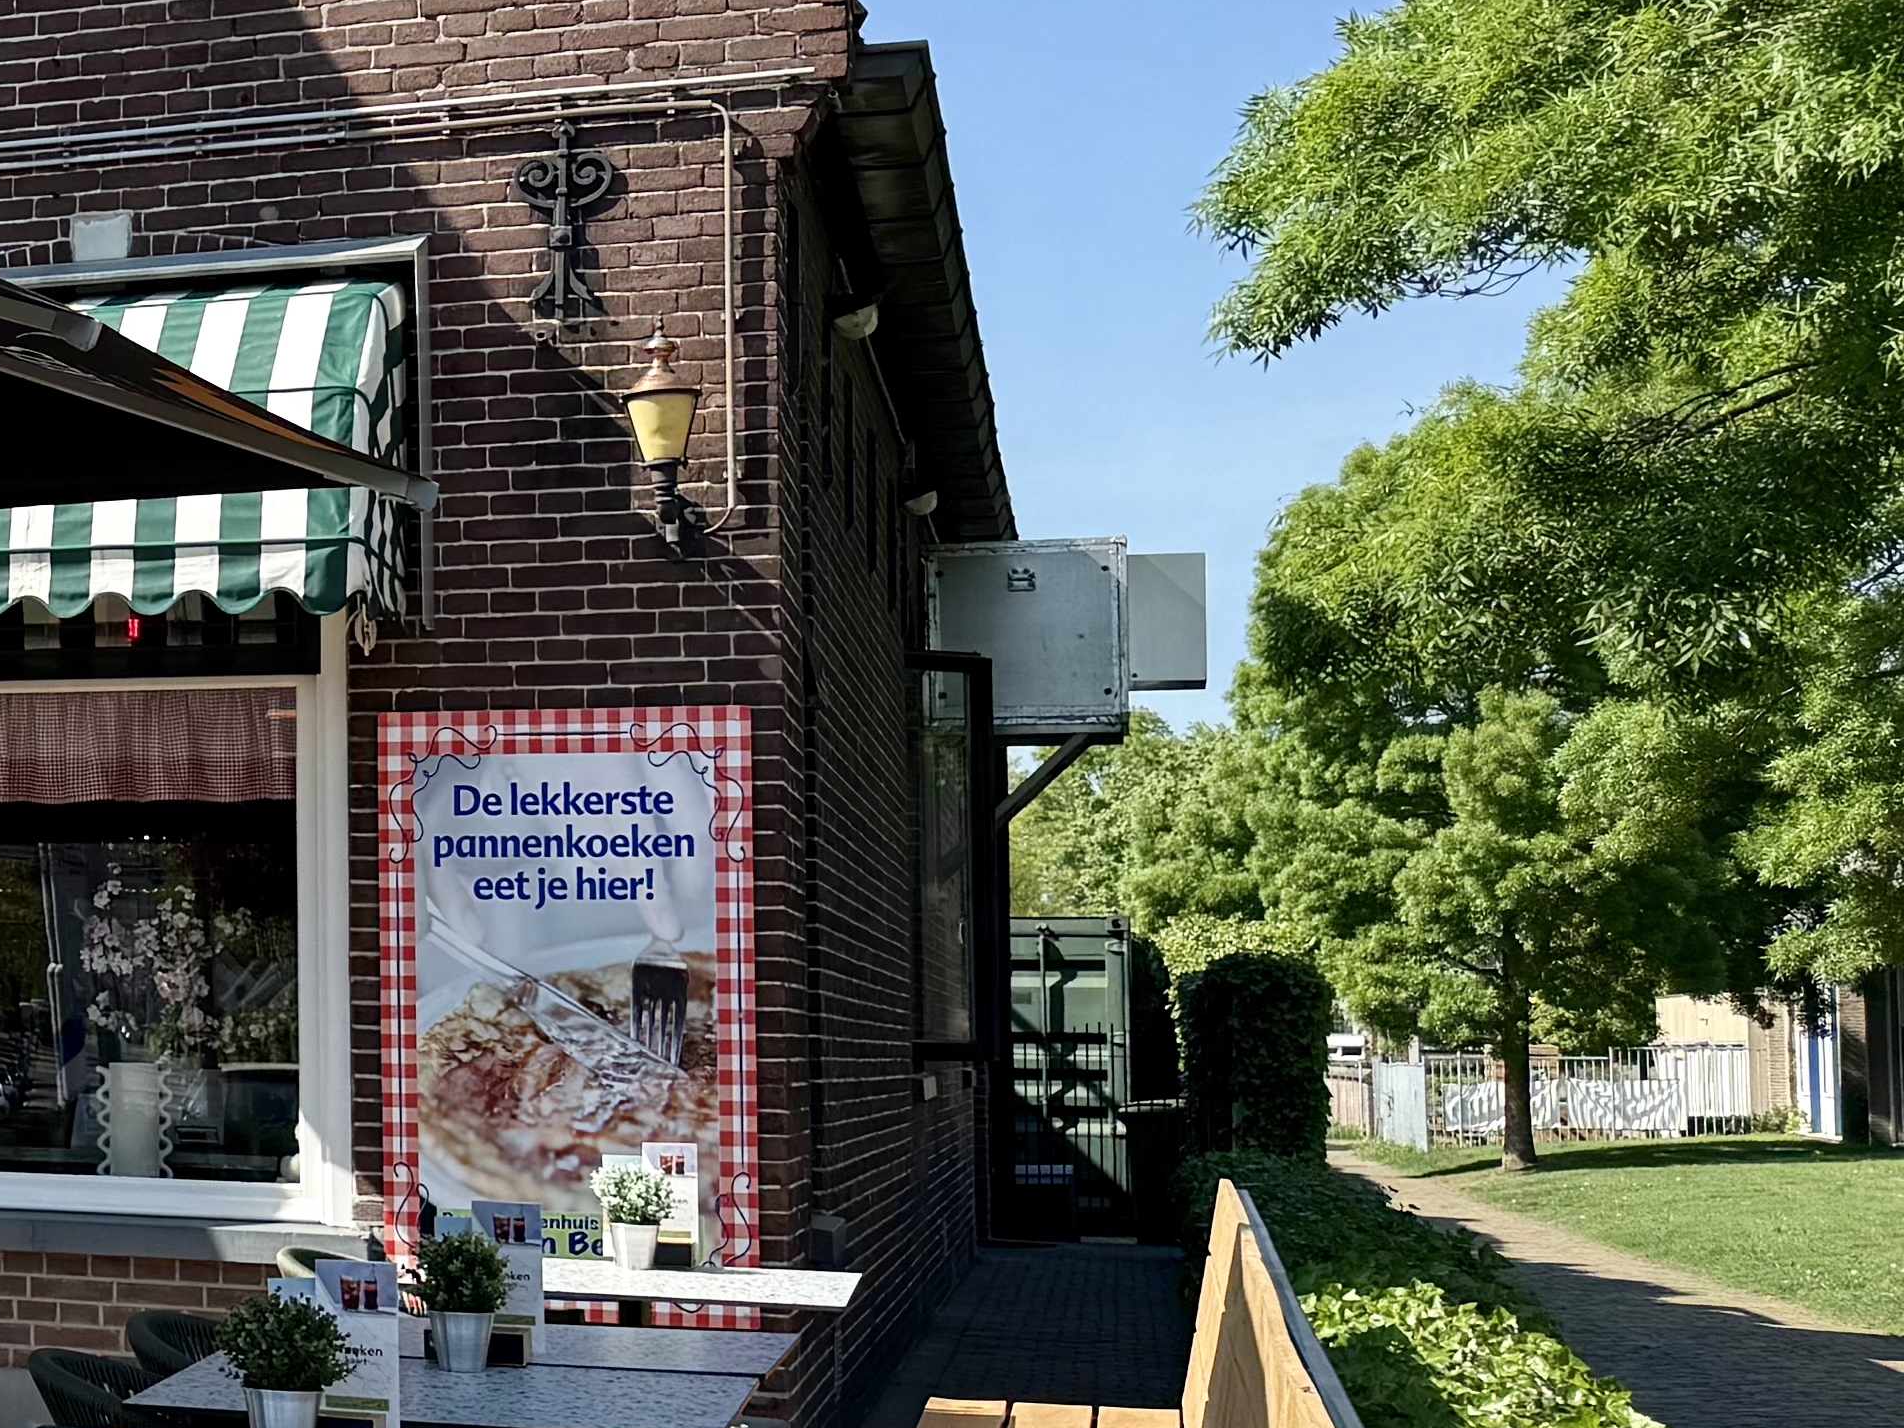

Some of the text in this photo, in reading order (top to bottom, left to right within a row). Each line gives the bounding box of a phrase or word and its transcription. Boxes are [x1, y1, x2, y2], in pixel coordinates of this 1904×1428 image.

[452, 781, 674, 818] De lekkerste
[433, 825, 695, 868] pannenkoeken
[472, 867, 655, 910] eet je hier!
